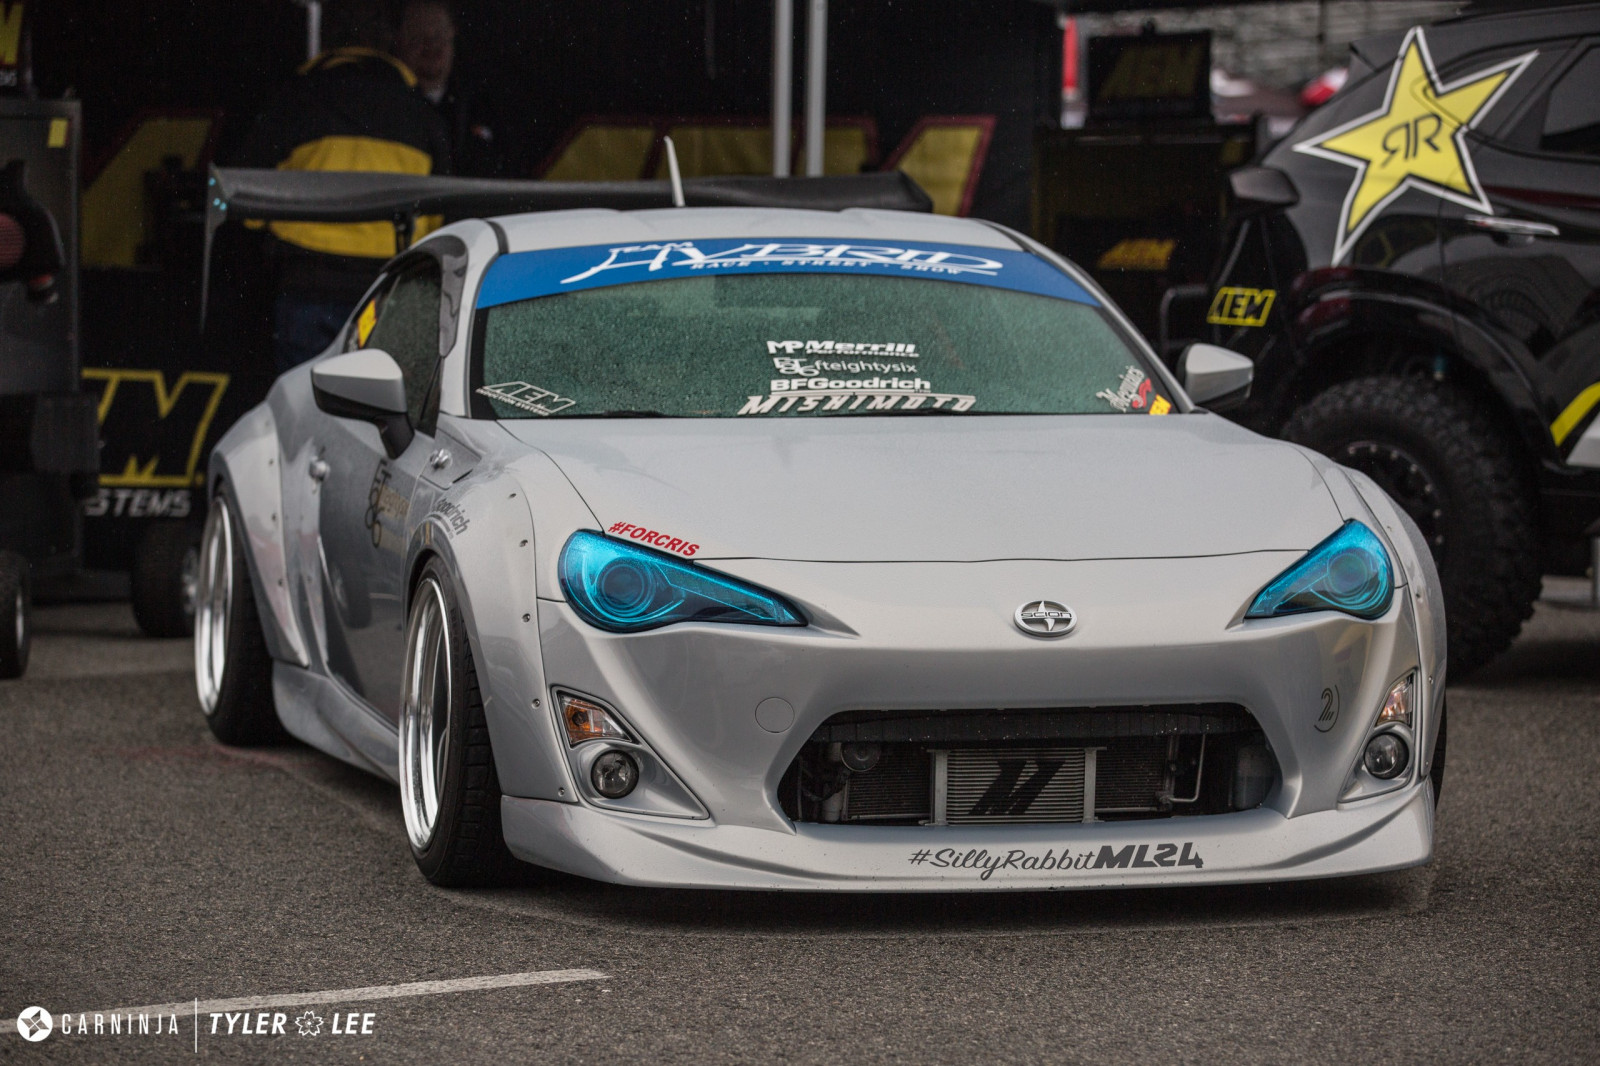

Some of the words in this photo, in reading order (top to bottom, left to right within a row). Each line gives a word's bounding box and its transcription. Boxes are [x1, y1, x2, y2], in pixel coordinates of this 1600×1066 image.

[805, 340, 916, 353] Merrill
[814, 360, 918, 374] fteightysix
[770, 377, 931, 392] BFGoodrich
[737, 394, 977, 415] MISHIMOTO
[608, 521, 700, 556] #FORCRIS
